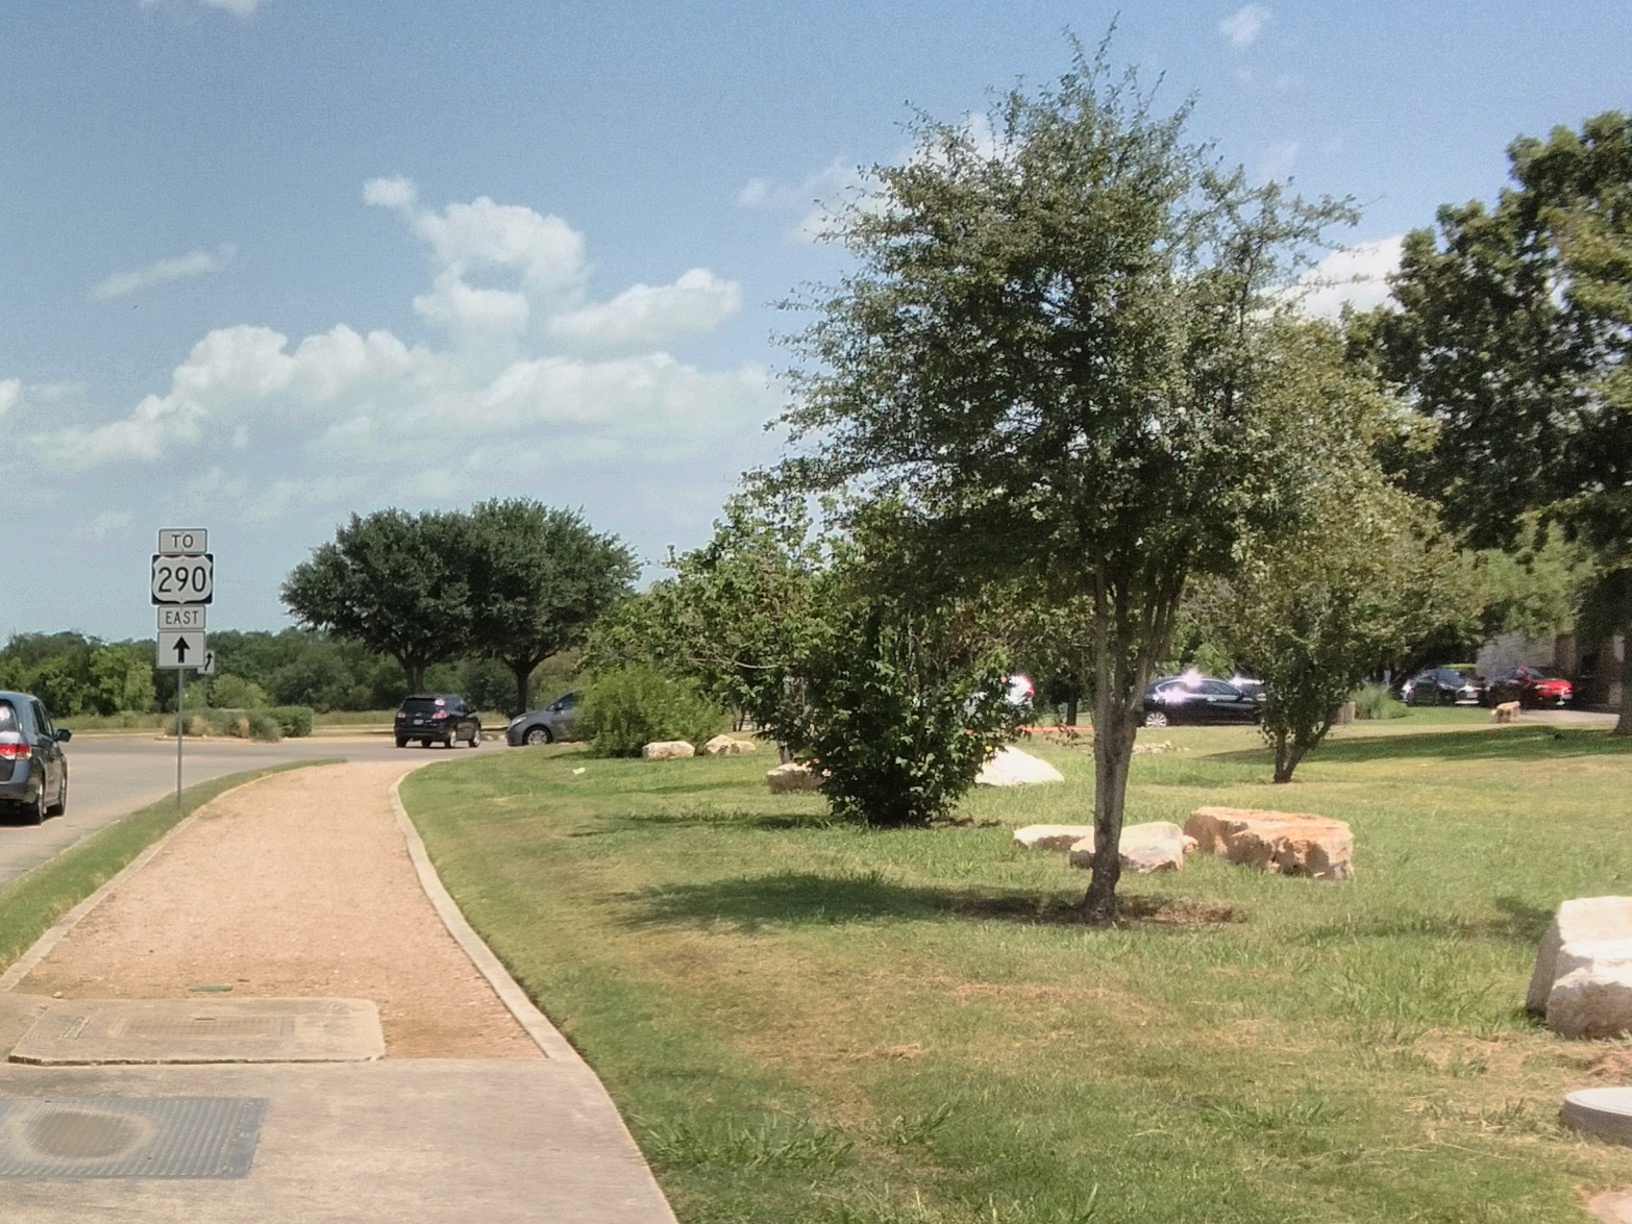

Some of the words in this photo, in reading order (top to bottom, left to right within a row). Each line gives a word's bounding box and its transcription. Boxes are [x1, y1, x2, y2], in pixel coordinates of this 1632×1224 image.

[171, 534, 194, 549] TO
[158, 566, 206, 593] 290
[165, 610, 199, 625] EAST
